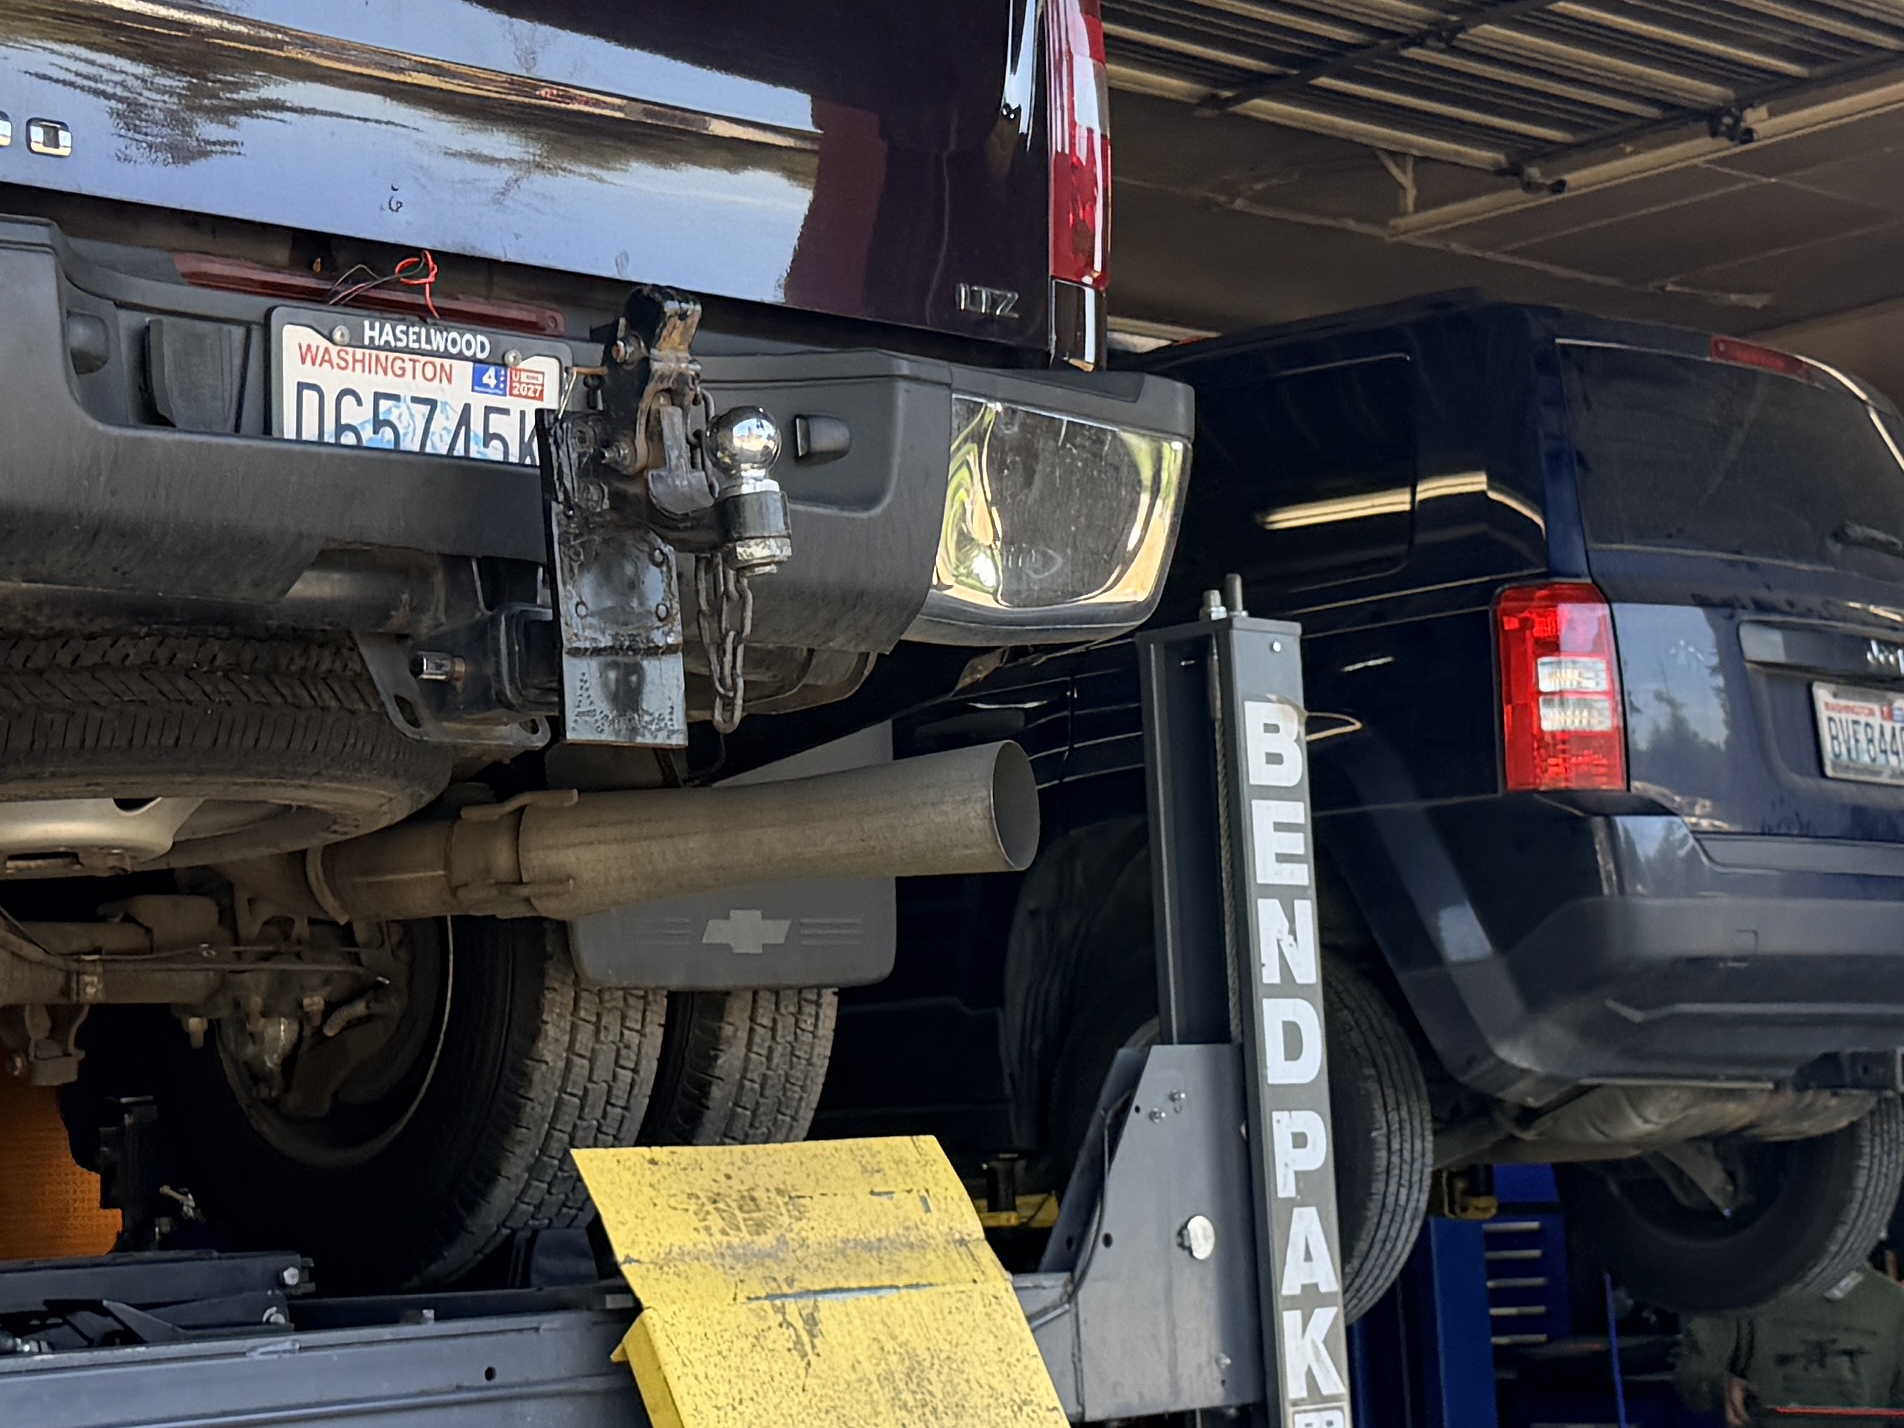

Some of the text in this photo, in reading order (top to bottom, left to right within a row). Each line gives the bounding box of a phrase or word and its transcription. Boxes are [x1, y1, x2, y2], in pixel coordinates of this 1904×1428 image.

[956, 283, 1019, 318] LTZ
[363, 320, 490, 360] HASELWOOD
[298, 342, 453, 385] WASHINGTON
[482, 366, 497, 389] 4
[512, 382, 542, 398] 2027
[1244, 699, 1346, 1400] BENDPAK
